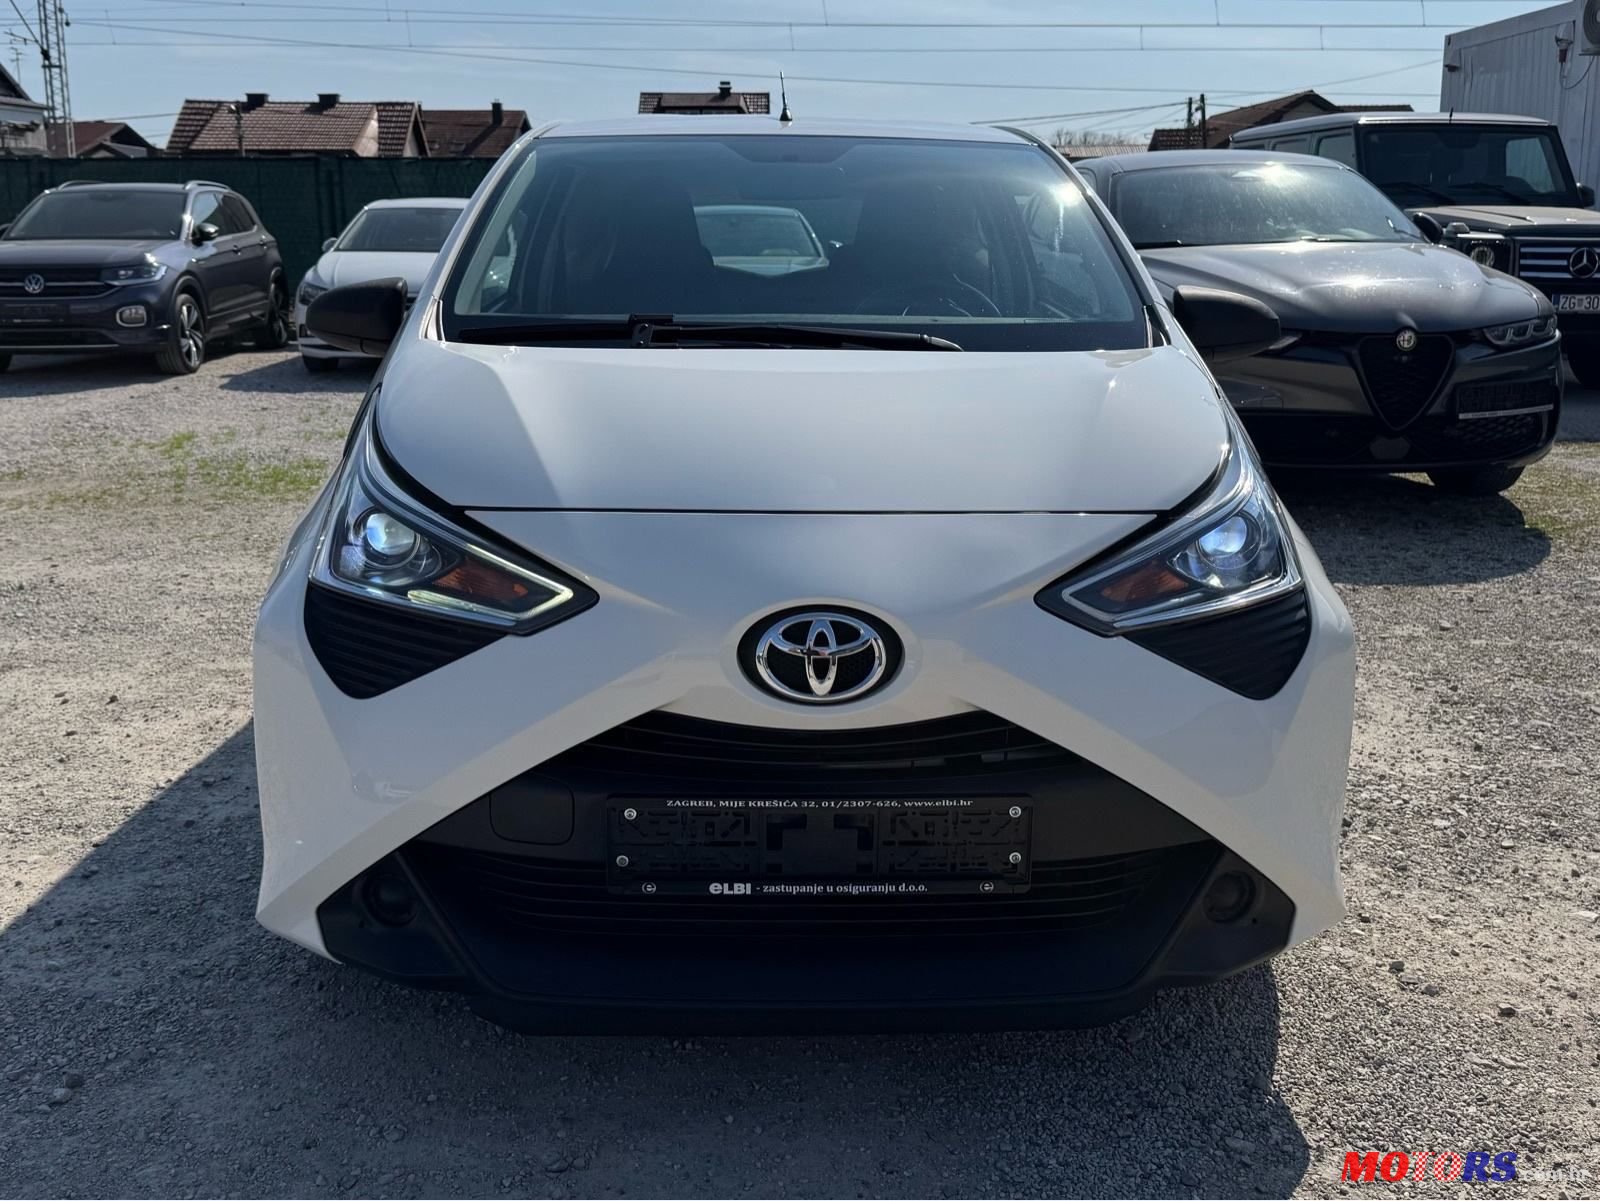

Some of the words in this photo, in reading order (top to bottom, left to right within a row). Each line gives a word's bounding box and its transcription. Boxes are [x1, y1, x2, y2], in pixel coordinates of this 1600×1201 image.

[1560, 296, 1576, 310] ZG
[666, 799, 716, 808] ZAGREB,
[719, 799, 746, 808] MIJE
[801, 799, 819, 808] 32,
[821, 799, 902, 809] 01/2307-626,
[904, 799, 974, 807] www.elbi.hr
[762, 883, 824, 895] zastupanje
[826, 885, 834, 893] u
[836, 882, 896, 895] osiguranju
[898, 882, 928, 892] d.o.o.
